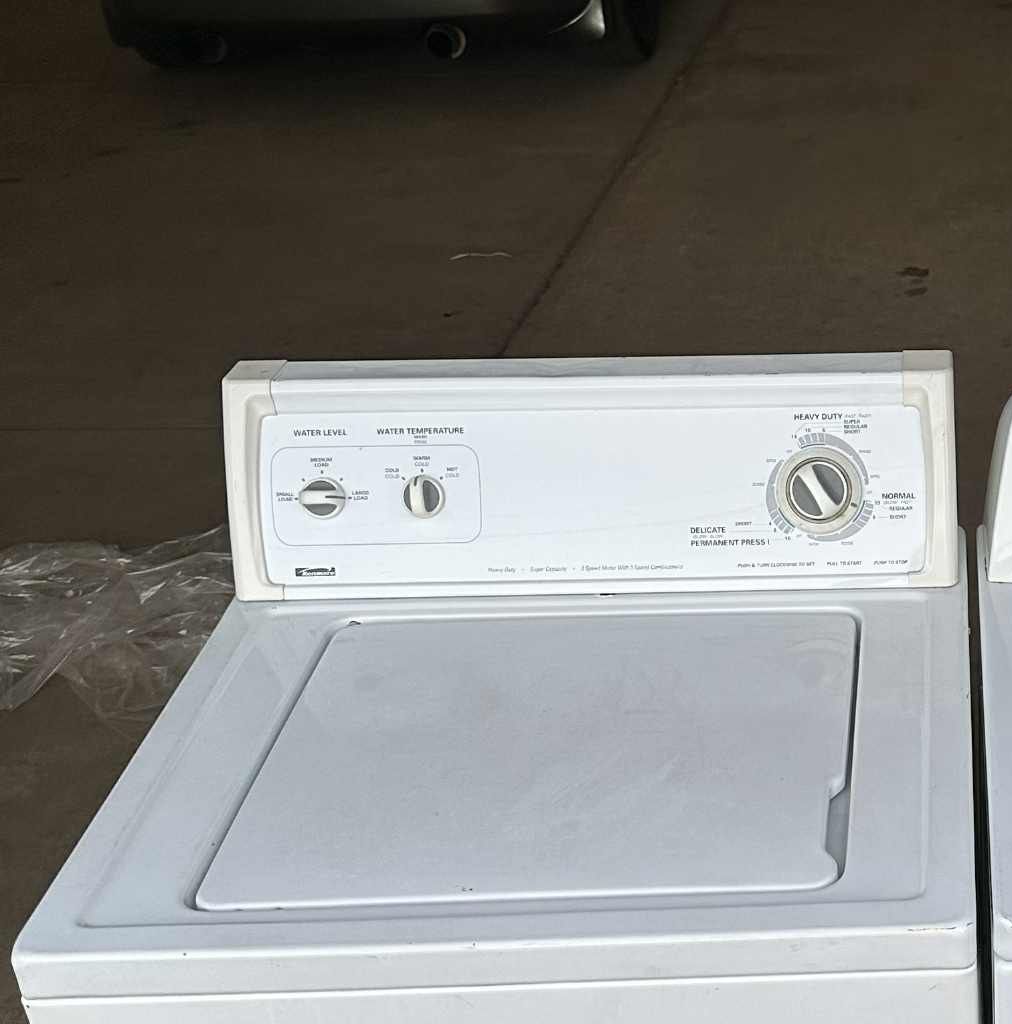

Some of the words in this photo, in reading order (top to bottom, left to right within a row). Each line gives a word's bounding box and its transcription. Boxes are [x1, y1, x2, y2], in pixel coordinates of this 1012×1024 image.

[821, 412, 843, 420] DUTY
[293, 428, 322, 437] WATER
[323, 428, 348, 437] LEVEL
[376, 427, 405, 435] WATER
[406, 426, 465, 435] TEMPERATURE
[689, 526, 727, 534] DELICATE
[690, 539, 740, 547] PERMANENT
[740, 538, 766, 546] PRESS
